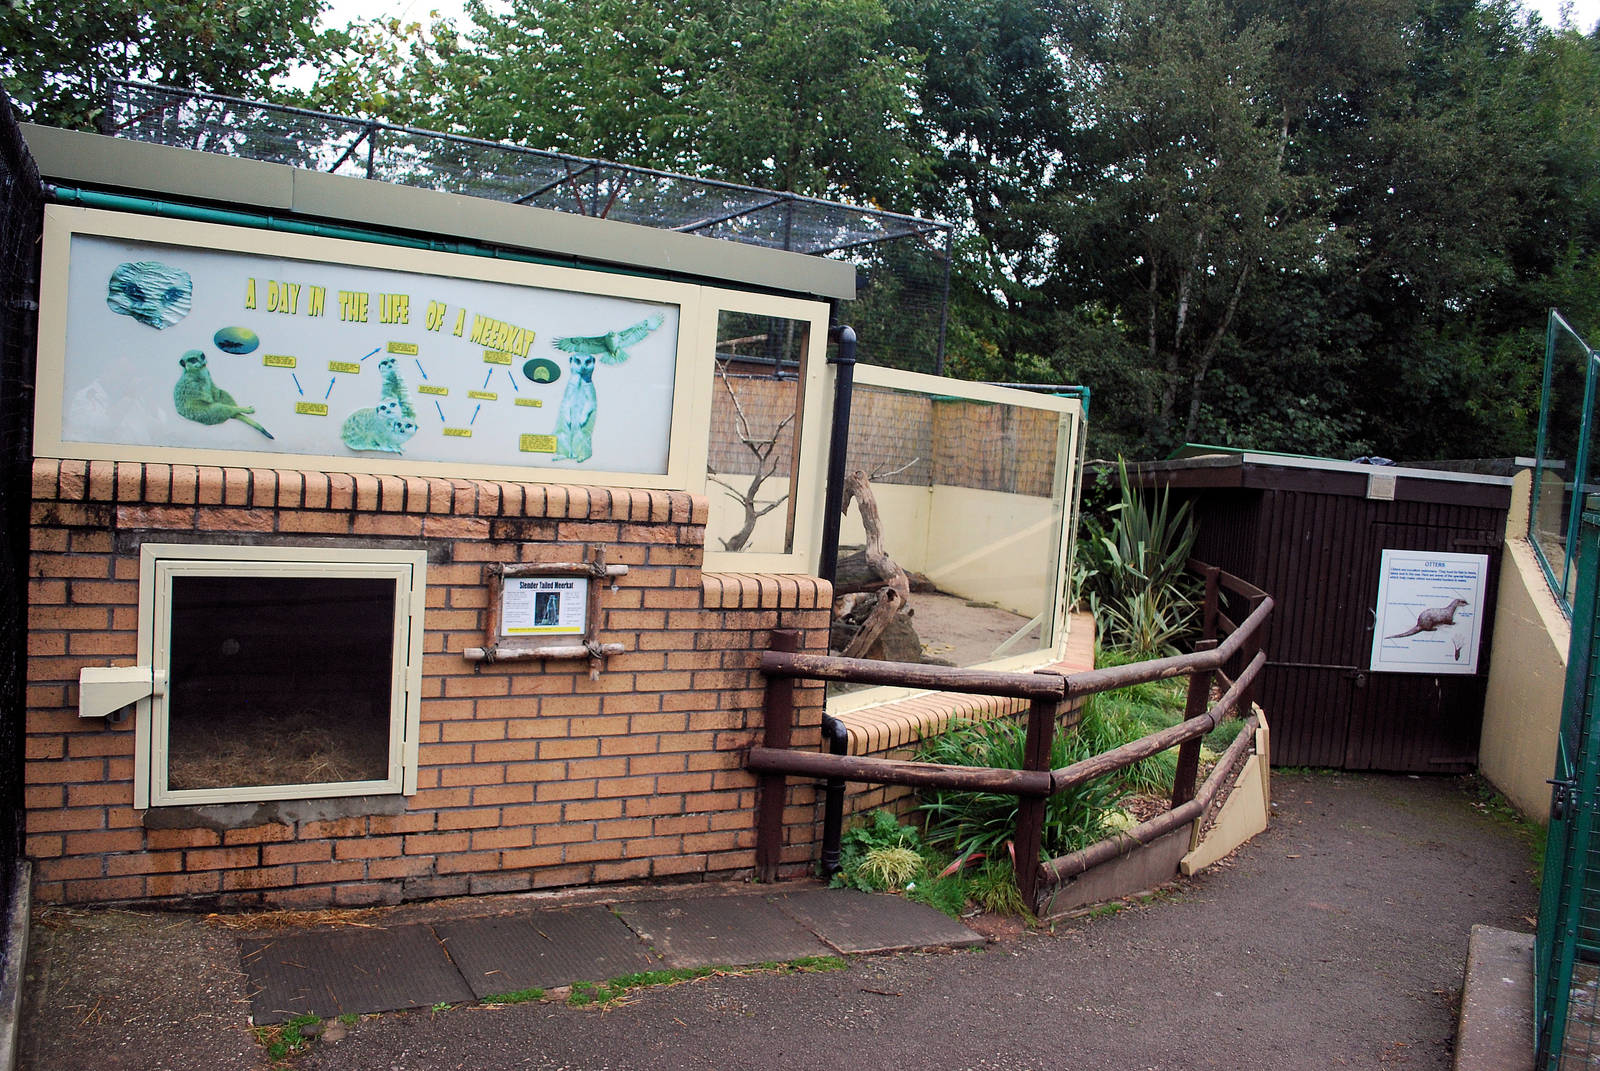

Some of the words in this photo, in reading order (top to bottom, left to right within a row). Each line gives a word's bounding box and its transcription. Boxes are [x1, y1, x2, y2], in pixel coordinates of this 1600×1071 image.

[245, 277, 257, 310] A
[267, 279, 301, 315] DAY
[308, 285, 326, 317] IN
[338, 290, 369, 322] THE
[379, 293, 410, 325] LIFE
[425, 300, 447, 332] OF
[453, 308, 466, 337] A
[470, 313, 536, 358] MEERKAT
[520, 581, 538, 590] Slender
[539, 581, 553, 589] Tailed
[554, 581, 574, 589] Meerkat
